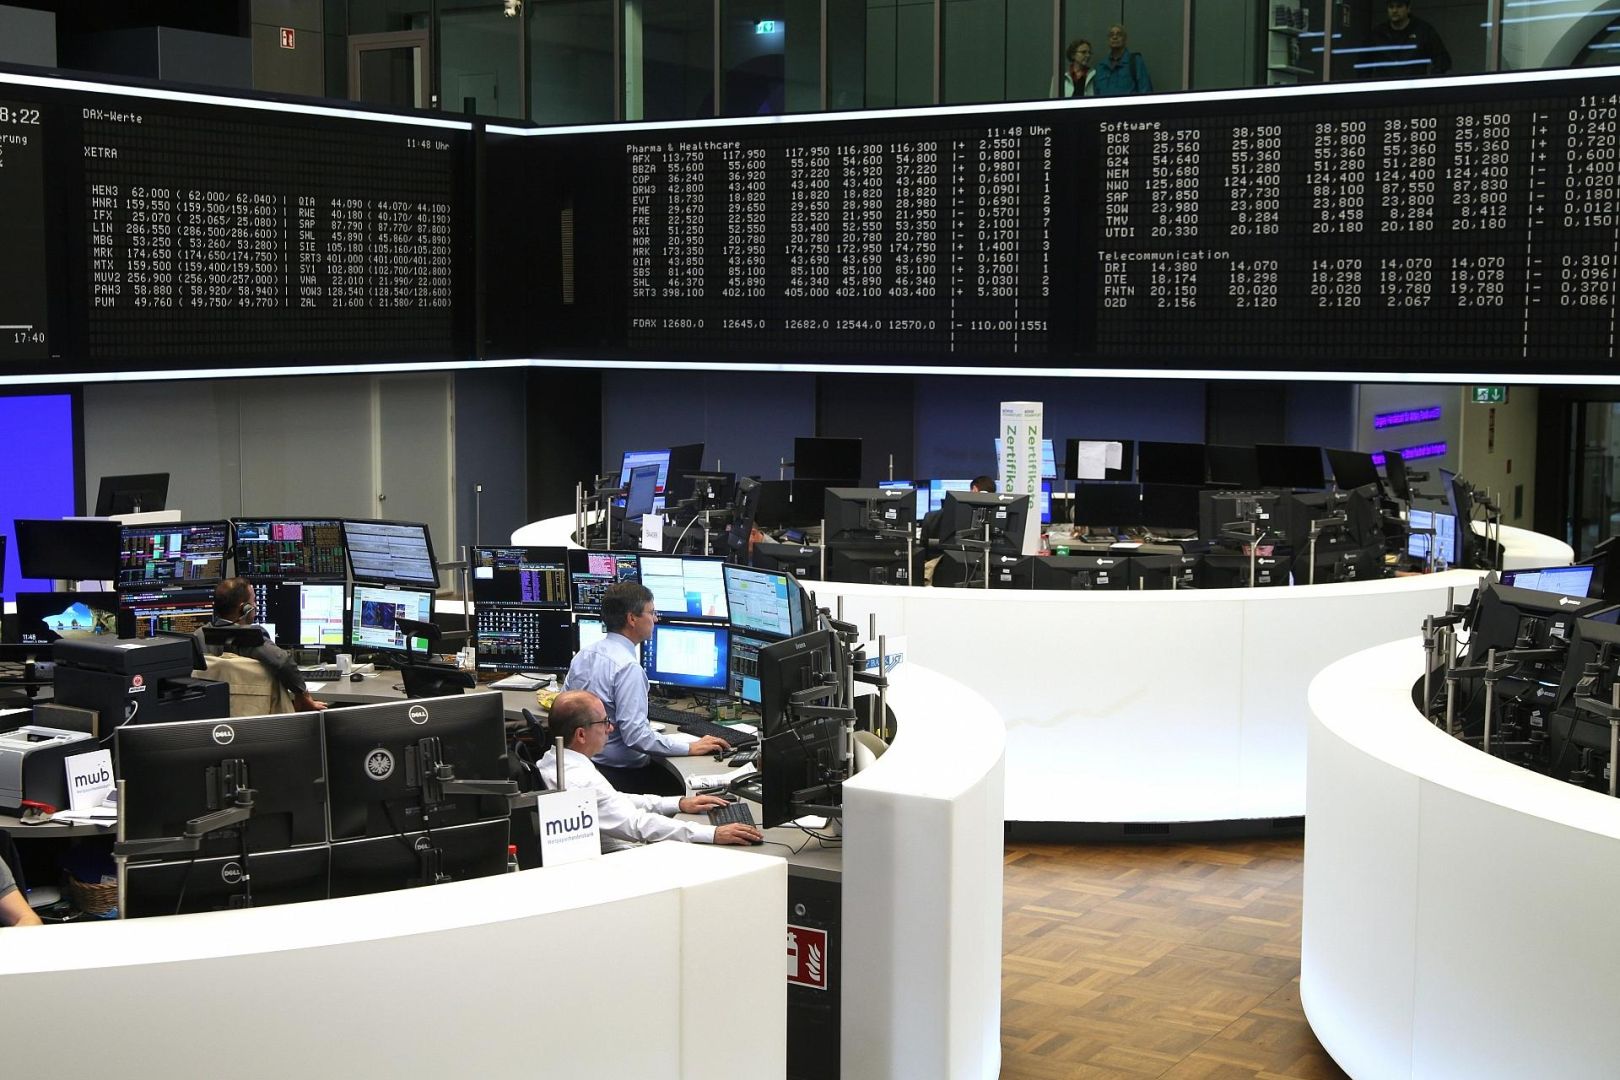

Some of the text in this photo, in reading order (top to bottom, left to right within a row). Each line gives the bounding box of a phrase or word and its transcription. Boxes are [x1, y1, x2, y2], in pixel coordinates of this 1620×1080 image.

[1580, 95, 1620, 107] 11:4
[0, 107, 40, 124] 8:22
[83, 109, 143, 124] DAX-Werte
[1100, 122, 1161, 132] Software
[626, 144, 662, 153] Pharma
[680, 141, 740, 152] Healthcare
[987, 127, 1022, 137] 11:48
[1030, 126, 1051, 136] Uhr
[1107, 126, 1281, 144] BC8 38,570 38,500
[407, 138, 450, 150] 11:48 Uhr
[1107, 138, 1281, 155] COK 25,560 25,800
[84, 146, 118, 158] XETRA
[632, 150, 766, 163] AFX 113,750 117,950
[1107, 151, 1281, 167] G24 54,640 55,360
[632, 160, 766, 173] BBZA 55,600 55,600
[1106, 163, 1280, 179] NEM 50,680 51,280
[632, 171, 766, 184] COP 36,240 36,920
[1106, 175, 1280, 190] NWO 125,800 124,400
[92, 185, 170, 200] HEN3 62,000
[632, 182, 766, 194] DRW3 42,800 43,400
[633, 192, 766, 204] EVT 18,730 18,820
[1106, 187, 1280, 202] SAP 87,850 87,730
[93, 197, 170, 212] HNR1 159,550
[298, 196, 362, 208] QIA 44,090
[1106, 200, 1280, 214] SOW 23,980 23,800
[299, 208, 363, 219] RWE 40,180
[633, 203, 766, 214] FME 29,670 29,650
[93, 210, 171, 224] IFX 25,070
[633, 214, 766, 225] FRE 22,520 22,520
[1106, 212, 1279, 225] TMV 8,400 8,284
[93, 222, 171, 236] LIN 286,550
[299, 219, 363, 230] SAP 87,790
[633, 224, 766, 235] GXI 51,250 52,550
[1106, 224, 1279, 237] UTDI 20,330 20,180
[94, 235, 171, 248] MBG 53,250
[299, 230, 363, 241] SHL 45,890
[633, 235, 766, 245] MOR 20,950 20,780
[299, 242, 363, 252] SIE 105,180
[633, 246, 766, 255] MRK 173,350 172,950
[94, 247, 172, 260] MRK 174,650
[300, 253, 363, 263] SRT3 401,000
[1098, 250, 1230, 261] Telecommunication
[94, 260, 172, 272] MTX 159,500
[633, 256, 766, 266] QIA 43,850 43,690
[1105, 260, 1278, 272] DRI 14,380 14,070
[300, 264, 363, 274] SY1 102,800
[633, 267, 766, 276] SBS 81,400 85,100
[94, 272, 172, 284] MUV2 256,900
[300, 275, 363, 285] VNA 22,010
[633, 278, 766, 286] SHL 46,370 45,890
[1105, 273, 1278, 284] DTE 18,174 18,298
[95, 285, 173, 296] PAH3 58,880
[300, 287, 363, 296] VOW3 128,540
[633, 288, 766, 296] SRT3 398,100 402,100
[1105, 285, 1277, 296] FNTN 20,150 20,020
[95, 297, 173, 308] PUM 49,760
[300, 298, 364, 307] ZAL 21,600
[1158, 298, 1197, 308] 2,156
[1236, 298, 1277, 307] 2,120
[633, 319, 766, 328] FDAX 12680,0 12645,0
[14, 333, 45, 344] 17:40
[1006, 425, 1016, 493] Zertifika
[1026, 425, 1038, 510] Zertifikate
[75, 768, 110, 788] mwb
[546, 810, 592, 836] mwb
